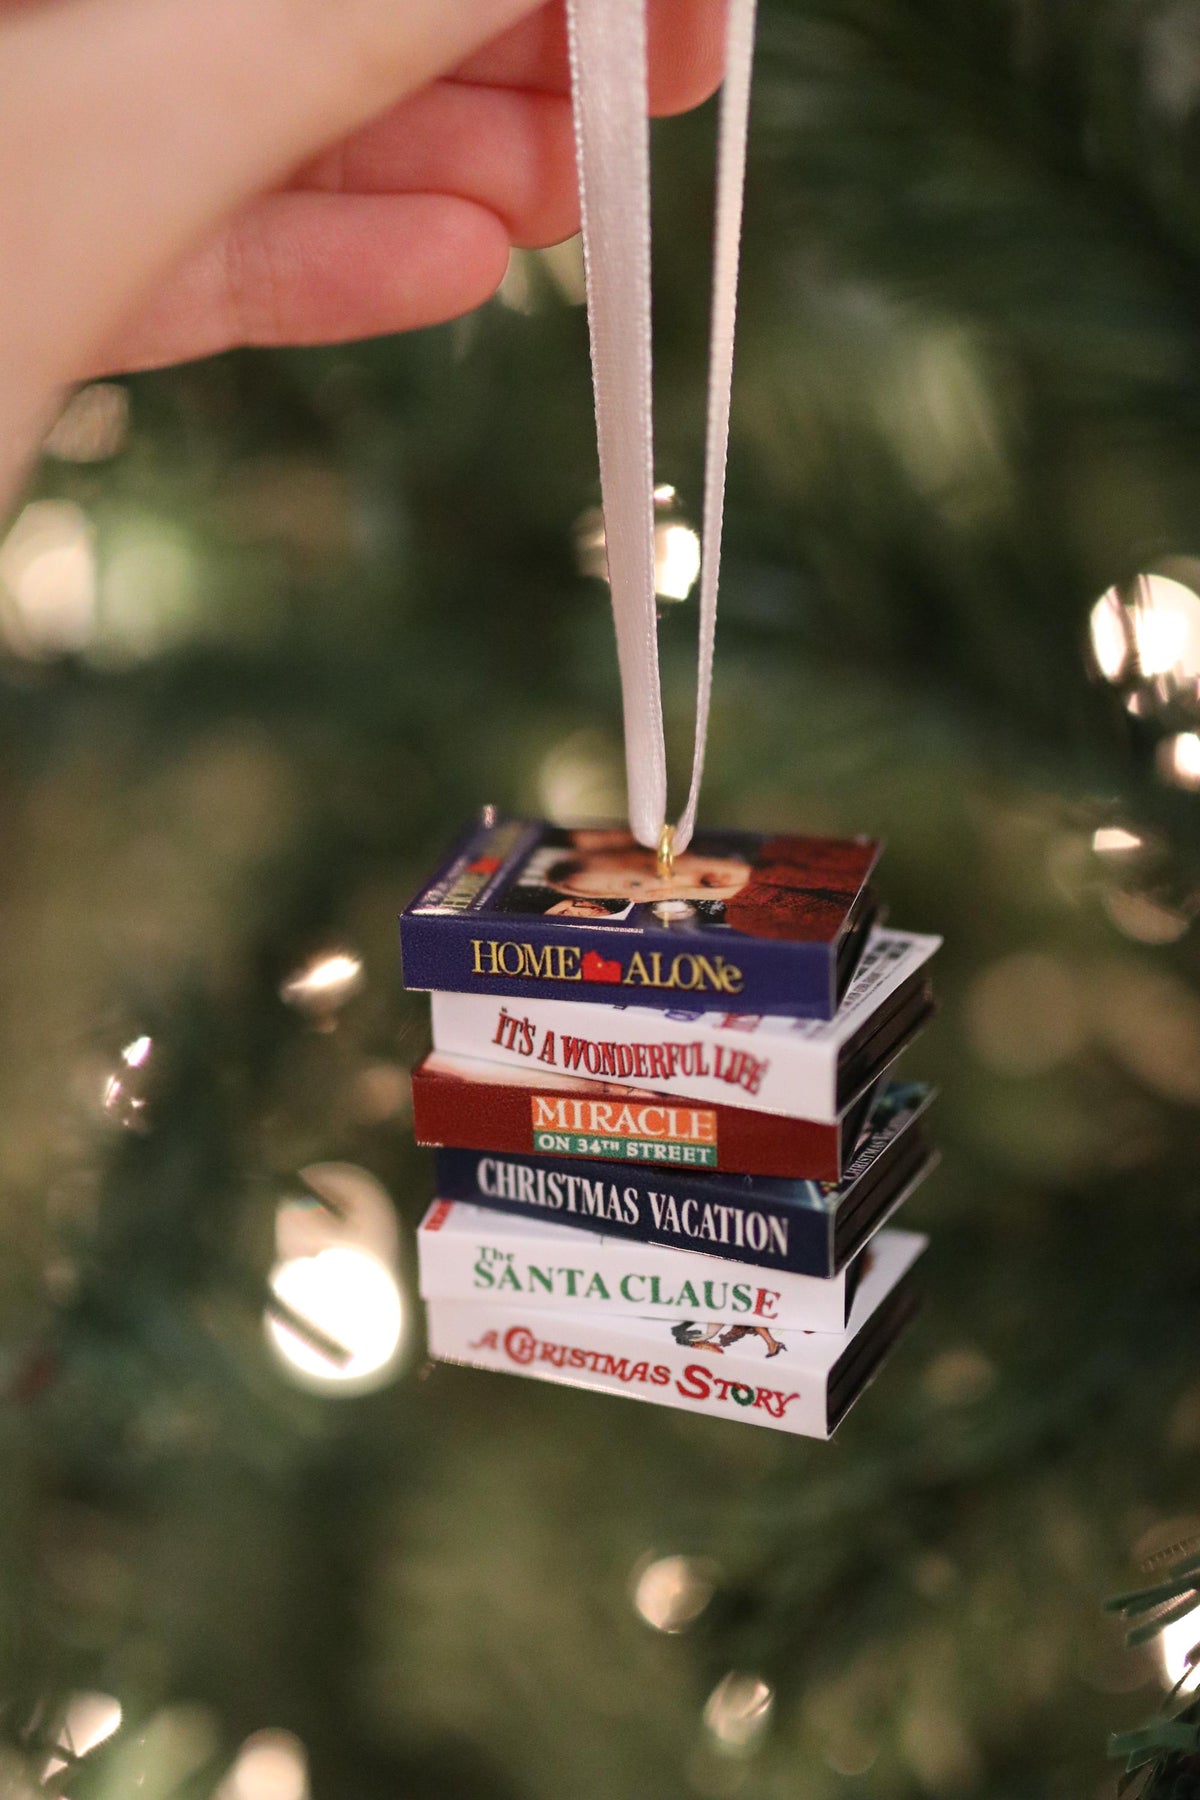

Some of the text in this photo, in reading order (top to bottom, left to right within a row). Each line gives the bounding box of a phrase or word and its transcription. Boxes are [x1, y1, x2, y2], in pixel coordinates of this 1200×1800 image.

[471, 939, 583, 981] HOME
[537, 1030, 558, 1066] A
[560, 1035, 710, 1081] WONDERFUL
[713, 1042, 771, 1097] LIFE
[534, 1097, 715, 1141] MIRACLE
[537, 1134, 571, 1151] ON
[626, 1141, 712, 1165] STREET
[476, 1157, 640, 1226] CHRISTMAS
[647, 1190, 789, 1257] VACATION
[475, 1246, 515, 1263] The
[473, 1260, 782, 1320] SANTA CLAUSE
[468, 1328, 500, 1351] A
[503, 1325, 672, 1386] CHRISTMAS
